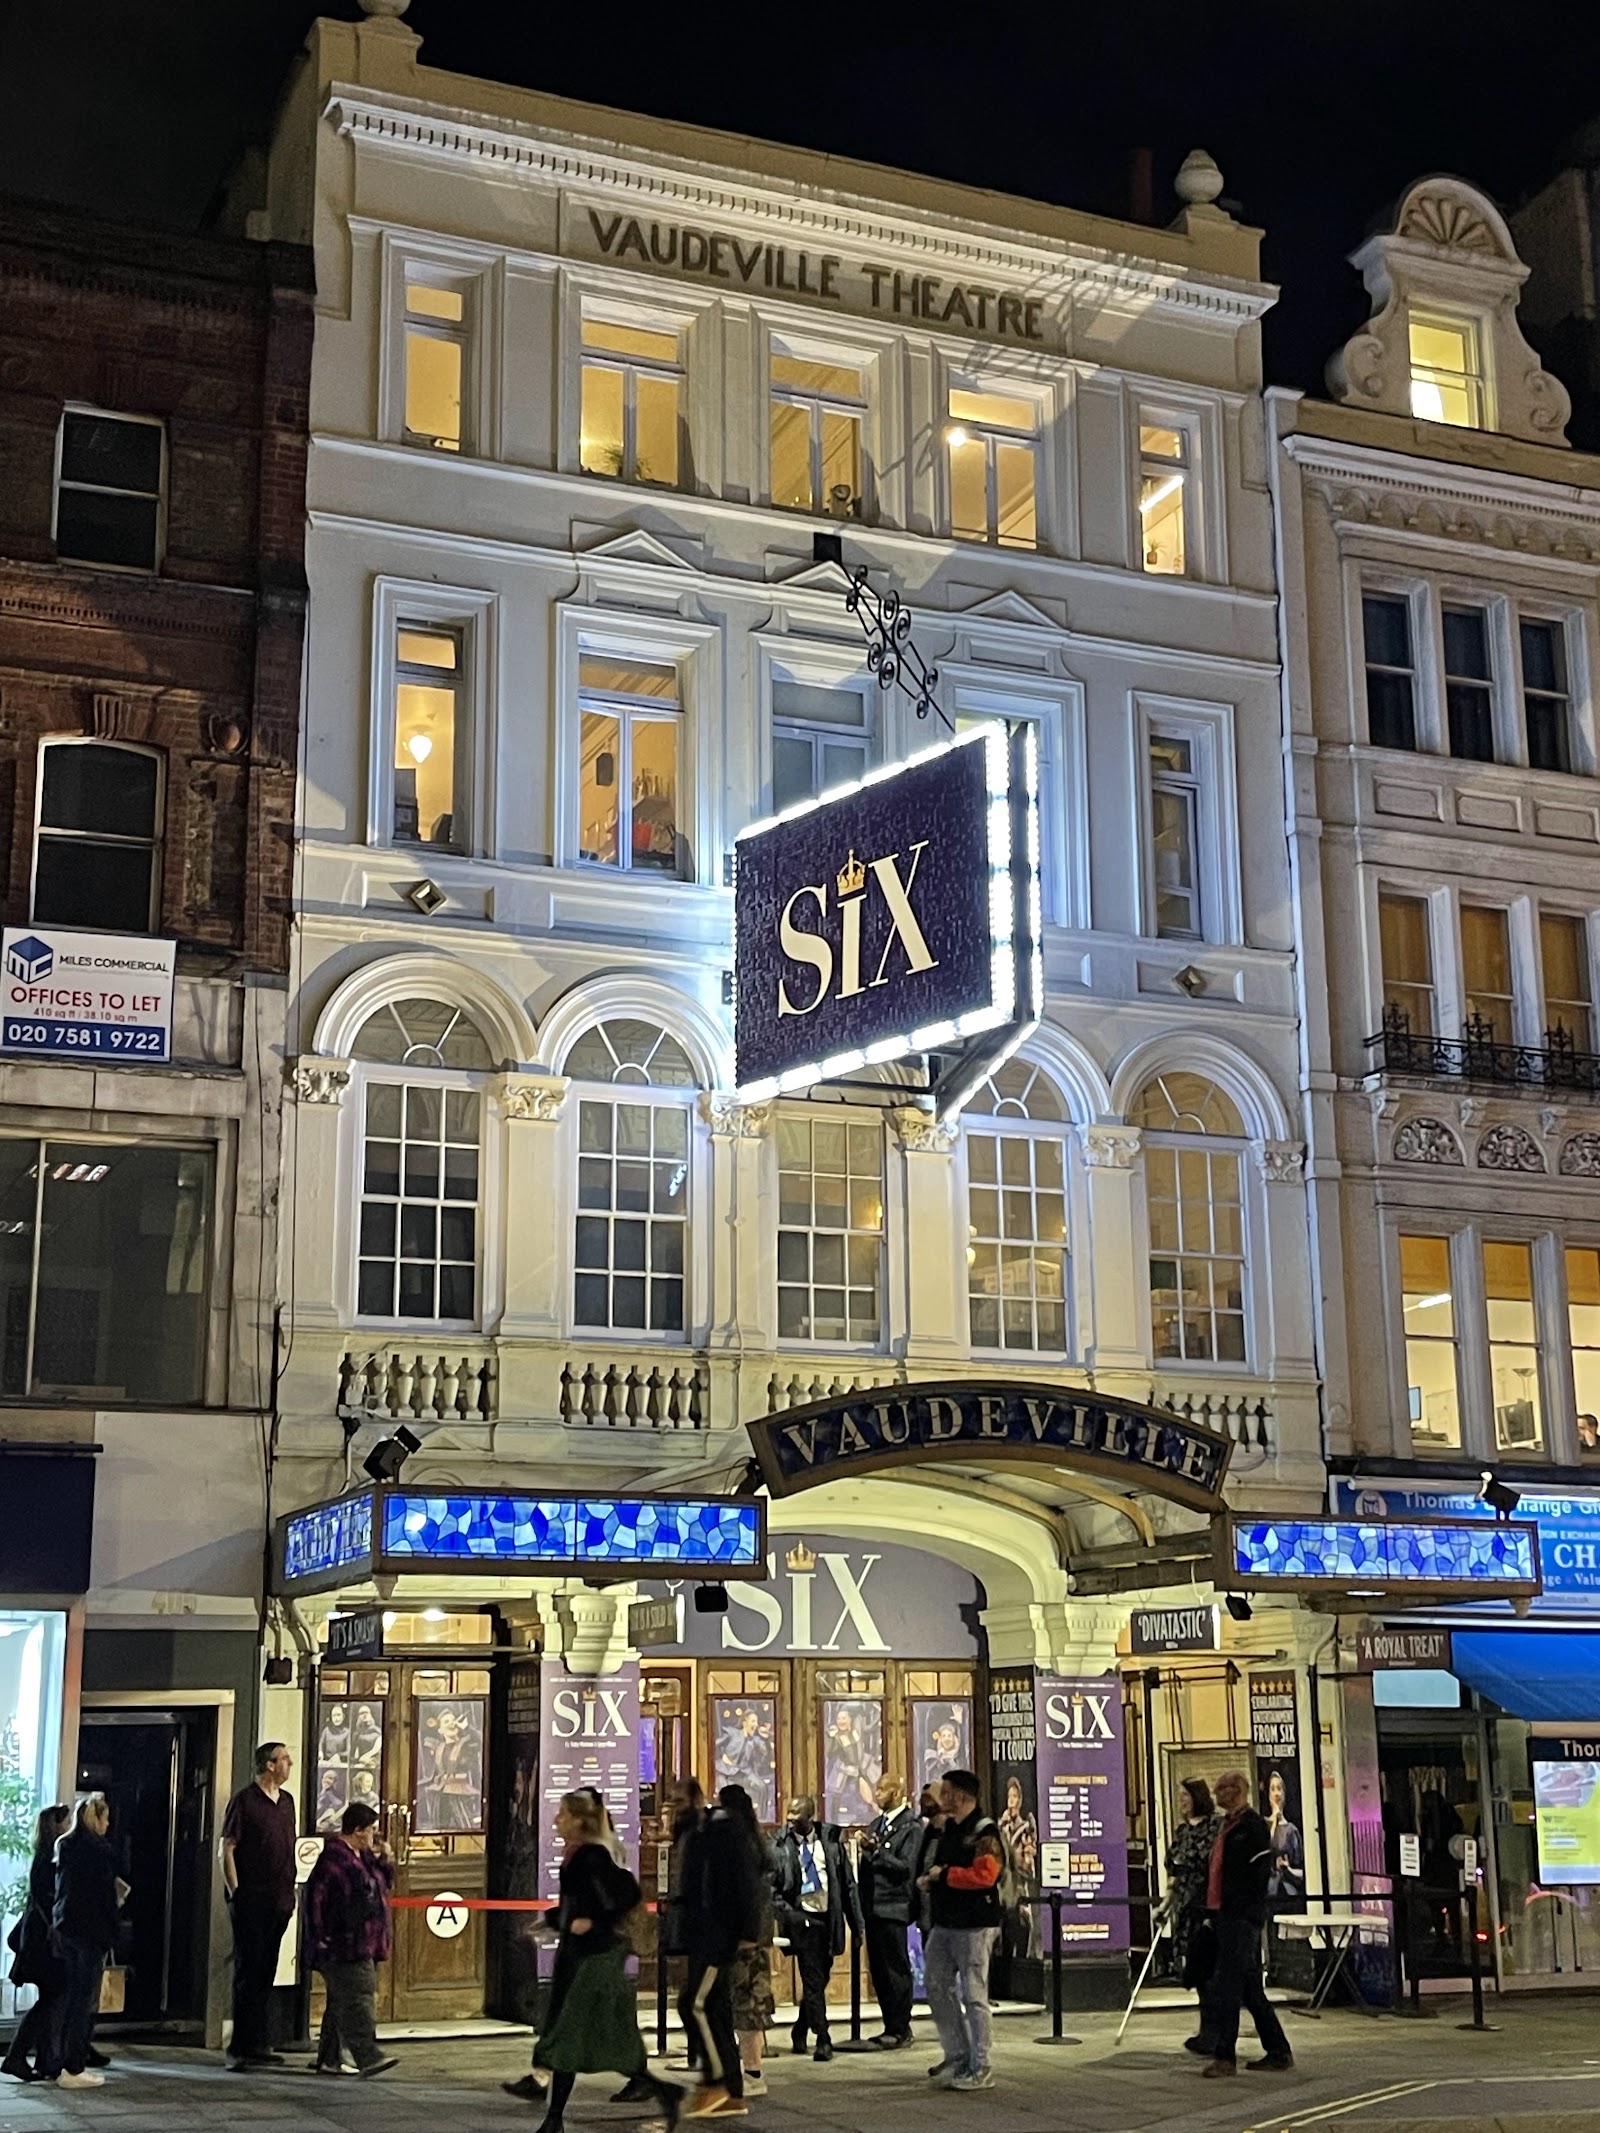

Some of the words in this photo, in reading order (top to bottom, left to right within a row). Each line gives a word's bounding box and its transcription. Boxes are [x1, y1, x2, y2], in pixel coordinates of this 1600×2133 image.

[588, 206, 840, 300] VAUDEVILLE
[862, 263, 1044, 341] THEATRE
[59, 955, 92, 967] MILES
[94, 957, 169, 972] COMMERCIAL
[11, 987, 93, 1008] OFFICES
[99, 992, 125, 1010] TO
[132, 995, 161, 1012] LET
[33, 1008, 52, 1017] 410
[54, 1010, 66, 1019] sq
[83, 1010, 111, 1020] 38.10
[114, 1014, 125, 1023] sq
[8, 1024, 47, 1043] 020
[54, 1027, 101, 1047] 7581
[110, 1031, 160, 1050] 9722
[782, 1395, 1212, 1483] VAUDEVILLE
[1401, 1490, 1476, 1511] Thomas
[1553, 1543, 1600, 1569] CH
[1373, 1635, 1407, 1659] ROYAL
[1253, 1723, 1278, 1743] FROM
[1279, 1723, 1296, 1743] SIX
[1001, 1741, 1006, 1761] I
[436, 1905, 458, 1926] A
